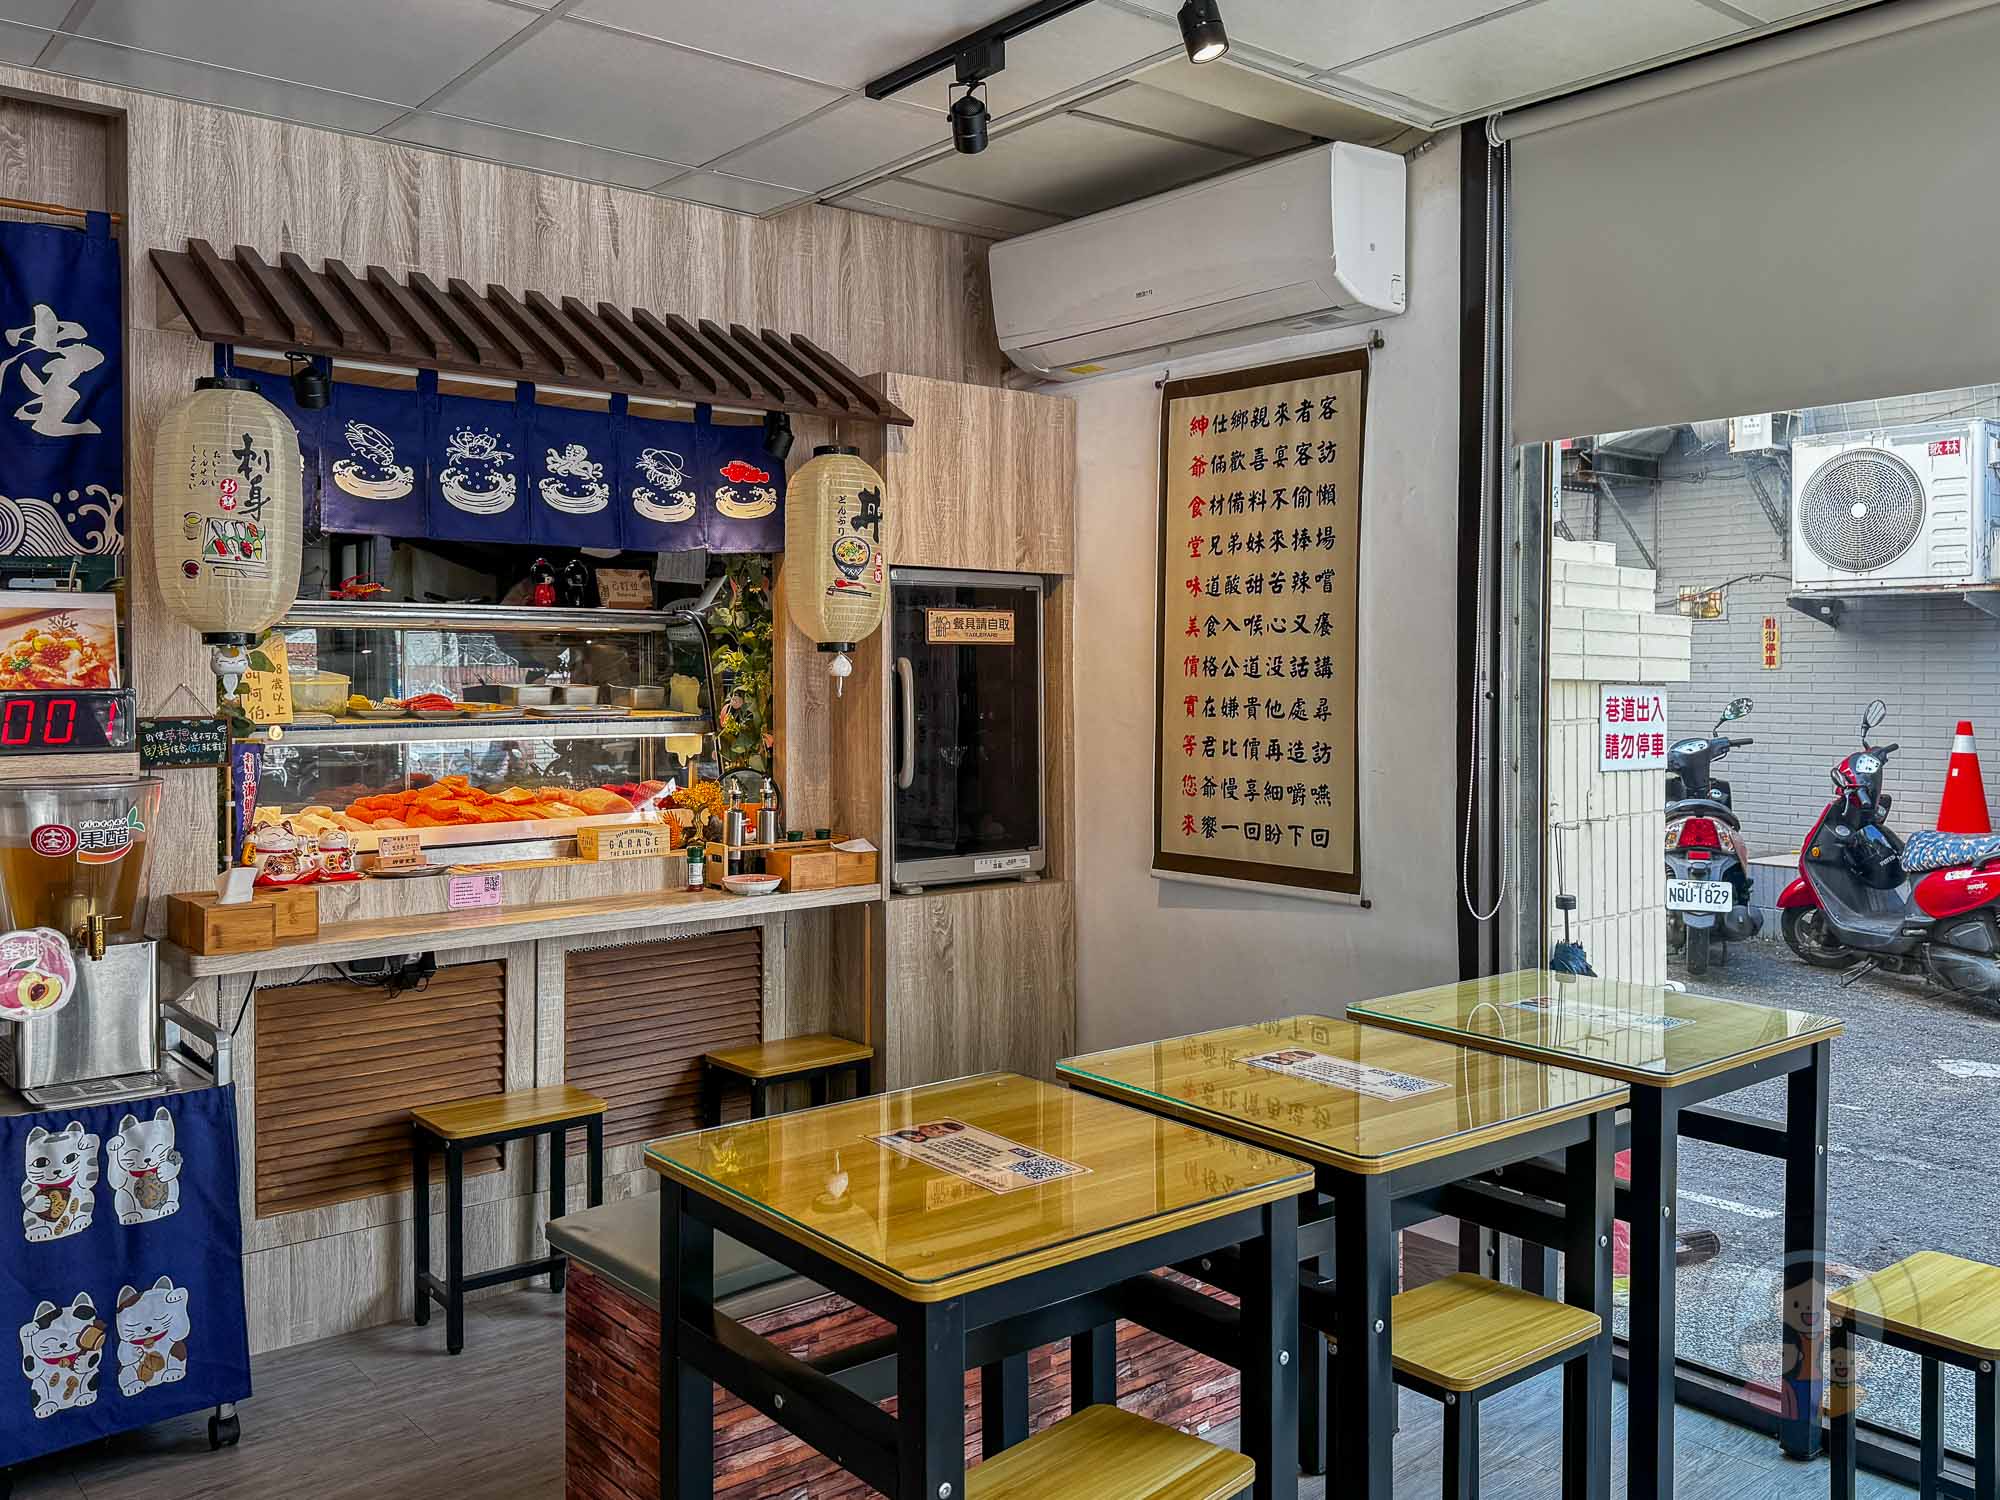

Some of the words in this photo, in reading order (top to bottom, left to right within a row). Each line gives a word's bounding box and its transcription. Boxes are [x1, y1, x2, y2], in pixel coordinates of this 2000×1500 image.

[1190, 396, 1338, 437] 紳仕鄉親來者客
[1189, 440, 1336, 478] 爺倆歡喜宴客訪
[232, 432, 271, 522] 刺身
[850, 485, 883, 544] 丼
[1188, 483, 1336, 518] 食材備料不偷懶
[837, 495, 847, 536] どんぶり
[1188, 527, 1335, 557] 堂兄弟妹來捧場
[1186, 569, 1335, 597] 味道酸甜苦辣嚐
[953, 616, 1009, 631] 餐具請自取
[1185, 612, 1333, 638] 美食入喉心又癢
[1184, 694, 1332, 722] 實在嫌貴他處尋
[1605, 696, 1664, 722] 巷道出入
[1183, 735, 1332, 764] 等君比價再造訪
[1605, 732, 1664, 760] 請勿停車
[1182, 774, 1331, 806] 您爺慢享細嚼嚥
[80, 816, 128, 828] vinegar
[1182, 814, 1329, 848] 來饗一回盼下回
[80, 827, 129, 848] 果醋
[609, 836, 659, 850] GARAGE
